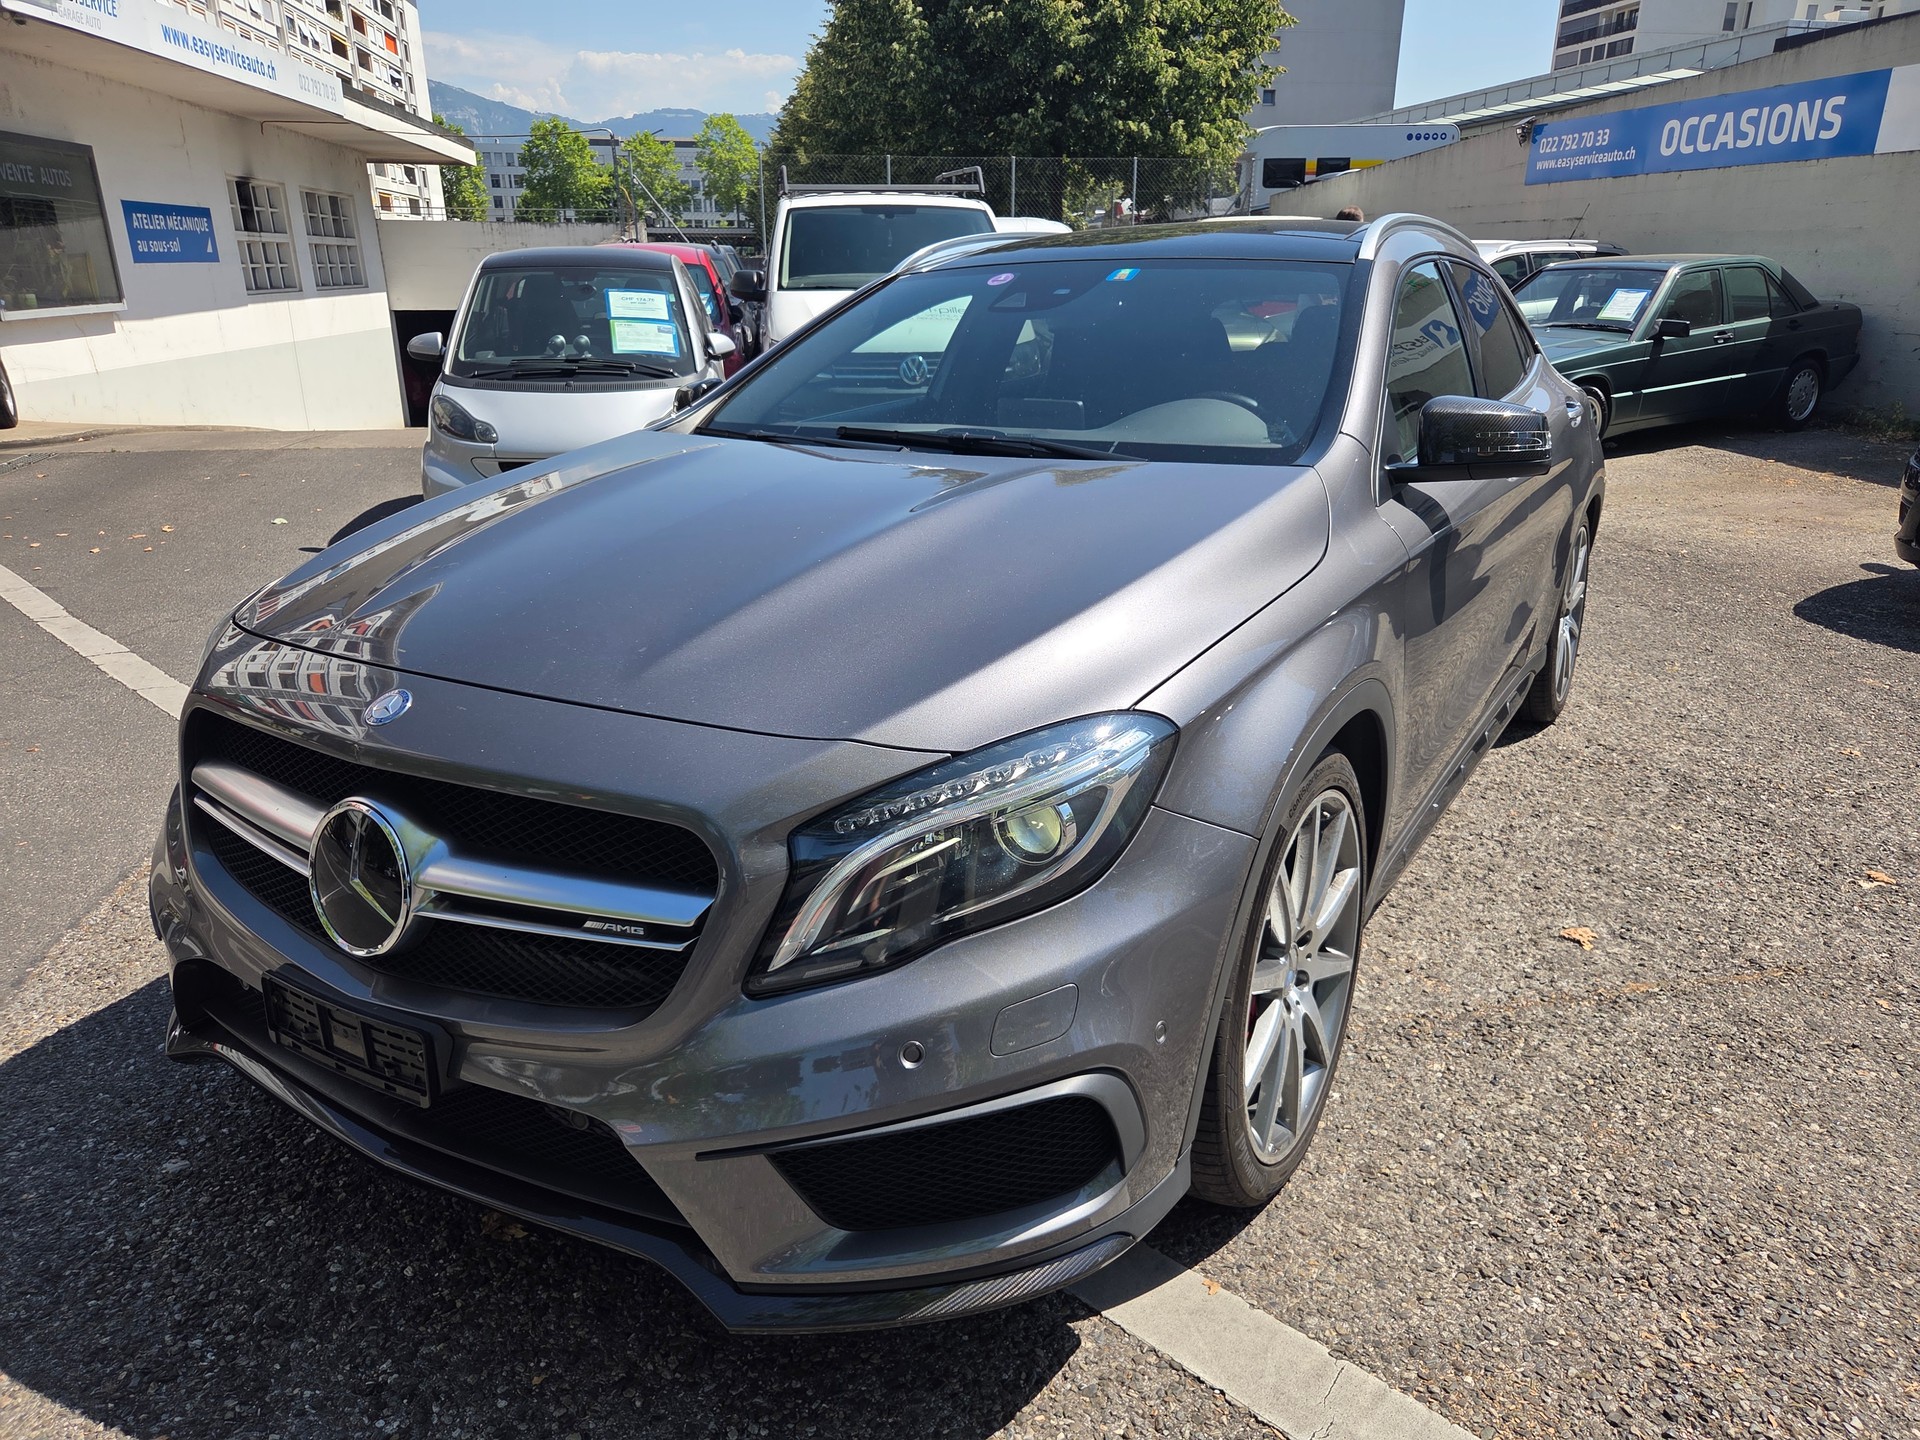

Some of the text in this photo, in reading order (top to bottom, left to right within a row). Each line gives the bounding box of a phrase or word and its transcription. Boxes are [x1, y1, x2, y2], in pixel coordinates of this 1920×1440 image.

[57, 6, 102, 31] GARAGE AUTO
[160, 23, 278, 81] www.easyserviceauto.ch
[298, 73, 338, 103] 022 792 70 33
[1660, 95, 1847, 157] OCCASIONS
[1540, 128, 1610, 154] 022 792 70 33
[1536, 146, 1636, 170] www.easyserviceauto.ch
[0, 162, 73, 188] VENTE AUTOS
[132, 211, 210, 235] ATELIER MÉCANIQUE
[136, 236, 181, 254] au sous-sol
[603, 922, 645, 935] AMG
